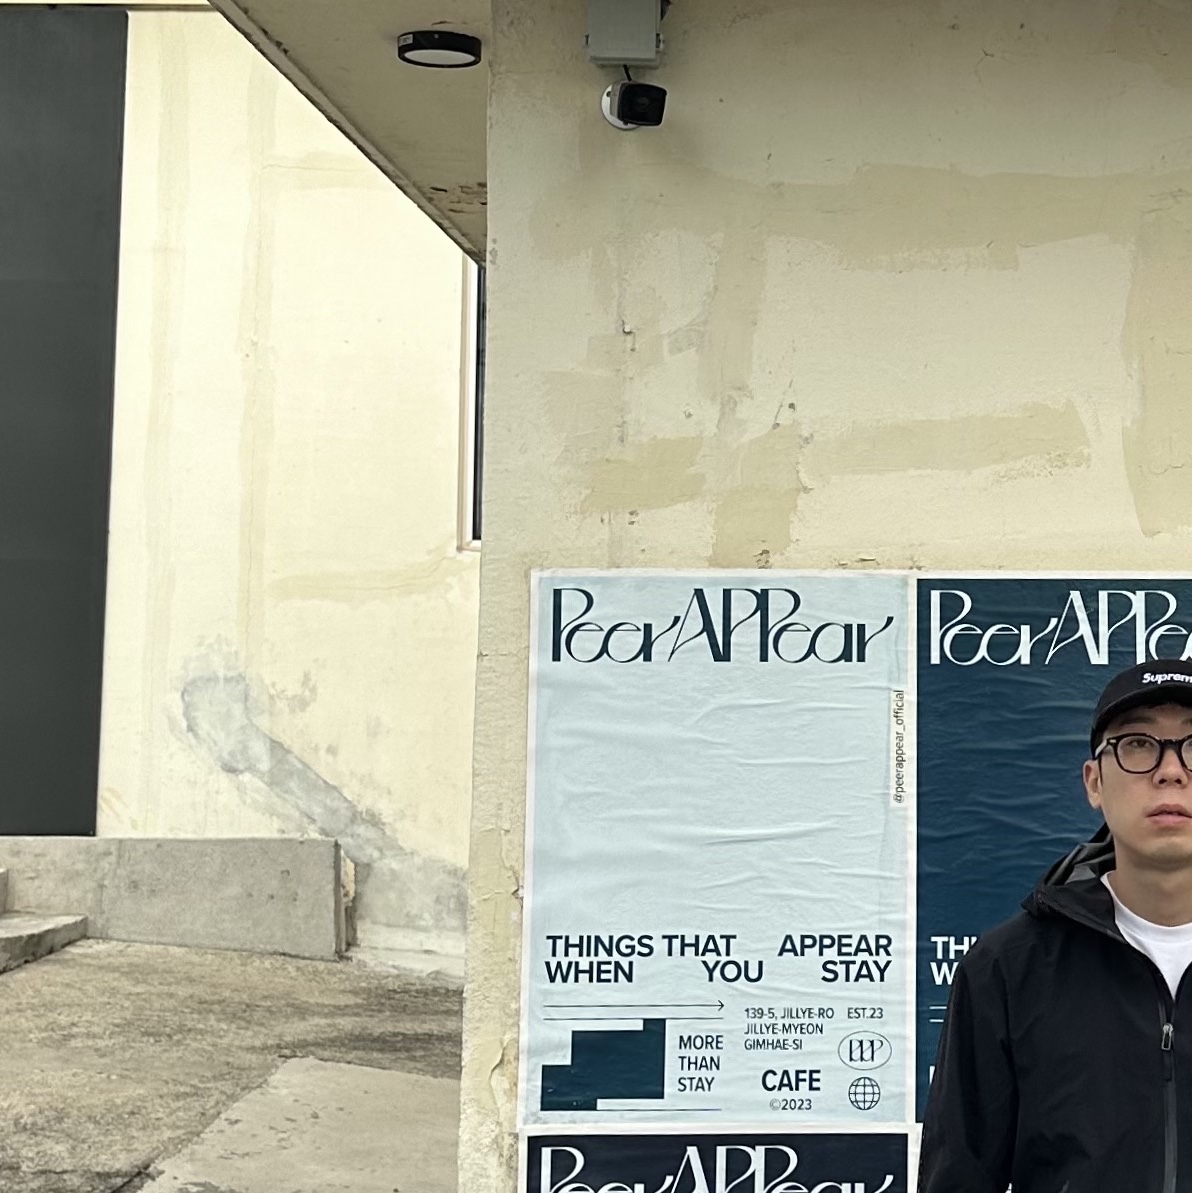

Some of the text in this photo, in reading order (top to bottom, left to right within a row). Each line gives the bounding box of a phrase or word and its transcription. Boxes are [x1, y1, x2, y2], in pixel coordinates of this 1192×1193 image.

[552, 588, 893, 663] PeerAPPear
[894, 690, 907, 804] @peerappear_official
[546, 935, 892, 957] THINGS THAT APPEAR
[545, 960, 891, 983] WHEN YOU STAY
[745, 1007, 834, 1020] 139-5, JILLYE-RO
[848, 1007, 883, 1019] EST.23
[745, 1023, 823, 1034] JILLYE-MYEON
[679, 1035, 723, 1050] MORE
[744, 1039, 802, 1050] GIMHAE-SI
[678, 1056, 720, 1070] THAN
[678, 1077, 714, 1092] STAY
[762, 1070, 820, 1091] CAFE
